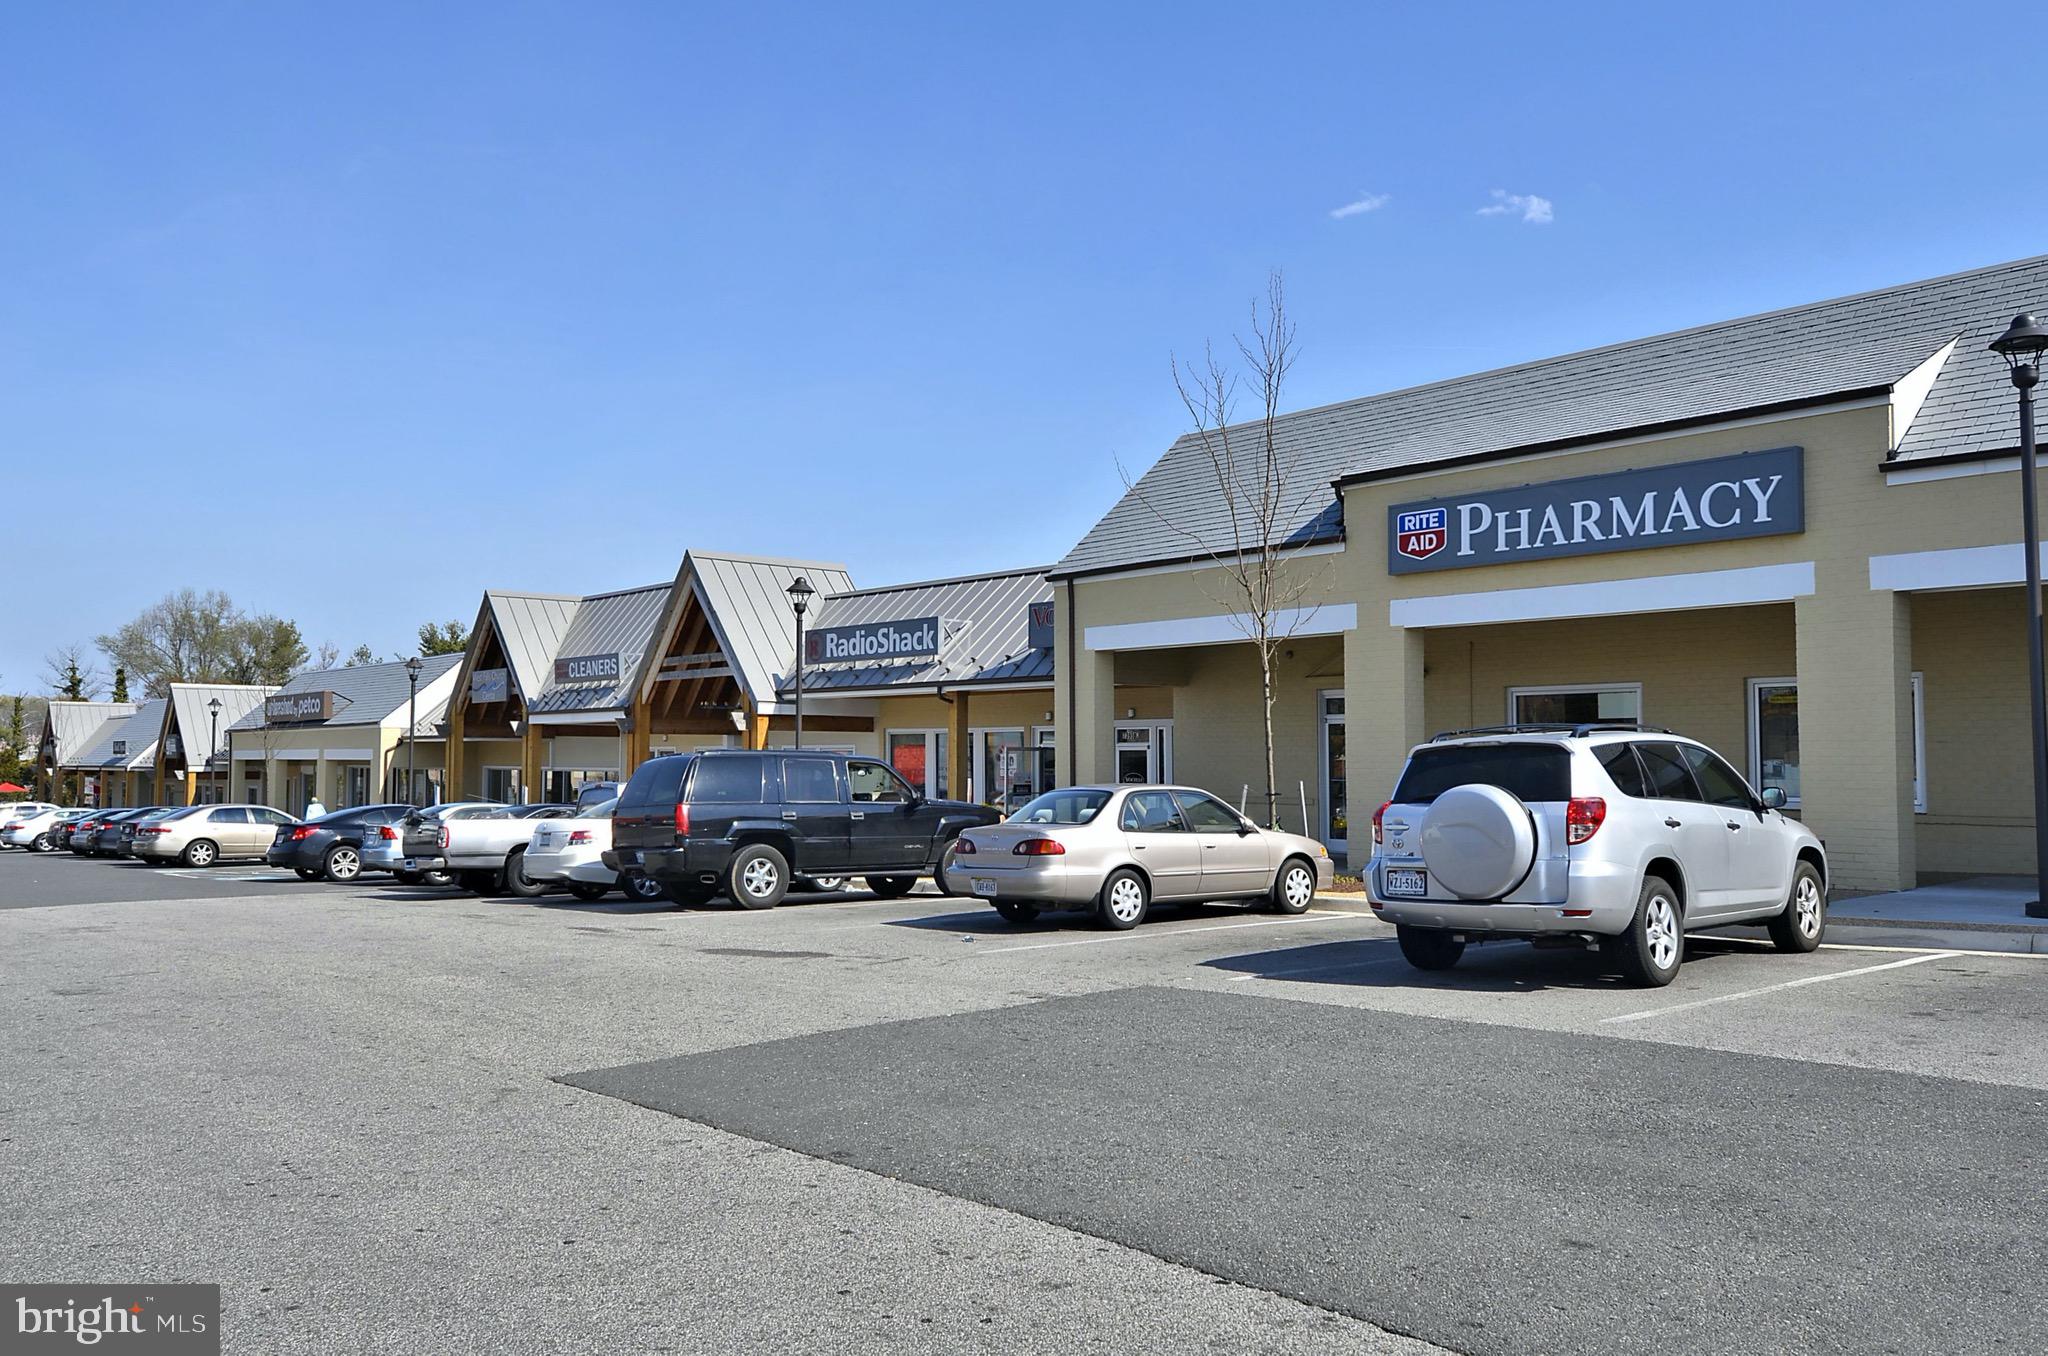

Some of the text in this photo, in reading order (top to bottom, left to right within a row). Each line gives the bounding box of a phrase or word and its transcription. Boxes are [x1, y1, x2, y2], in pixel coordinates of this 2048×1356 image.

[1404, 512, 1439, 531] RITE
[1456, 474, 1783, 556] PHARMACY
[1407, 533, 1437, 552] AID
[825, 623, 935, 658] RadioShack
[568, 658, 618, 678] CLEANERS
[298, 696, 321, 718] petco
